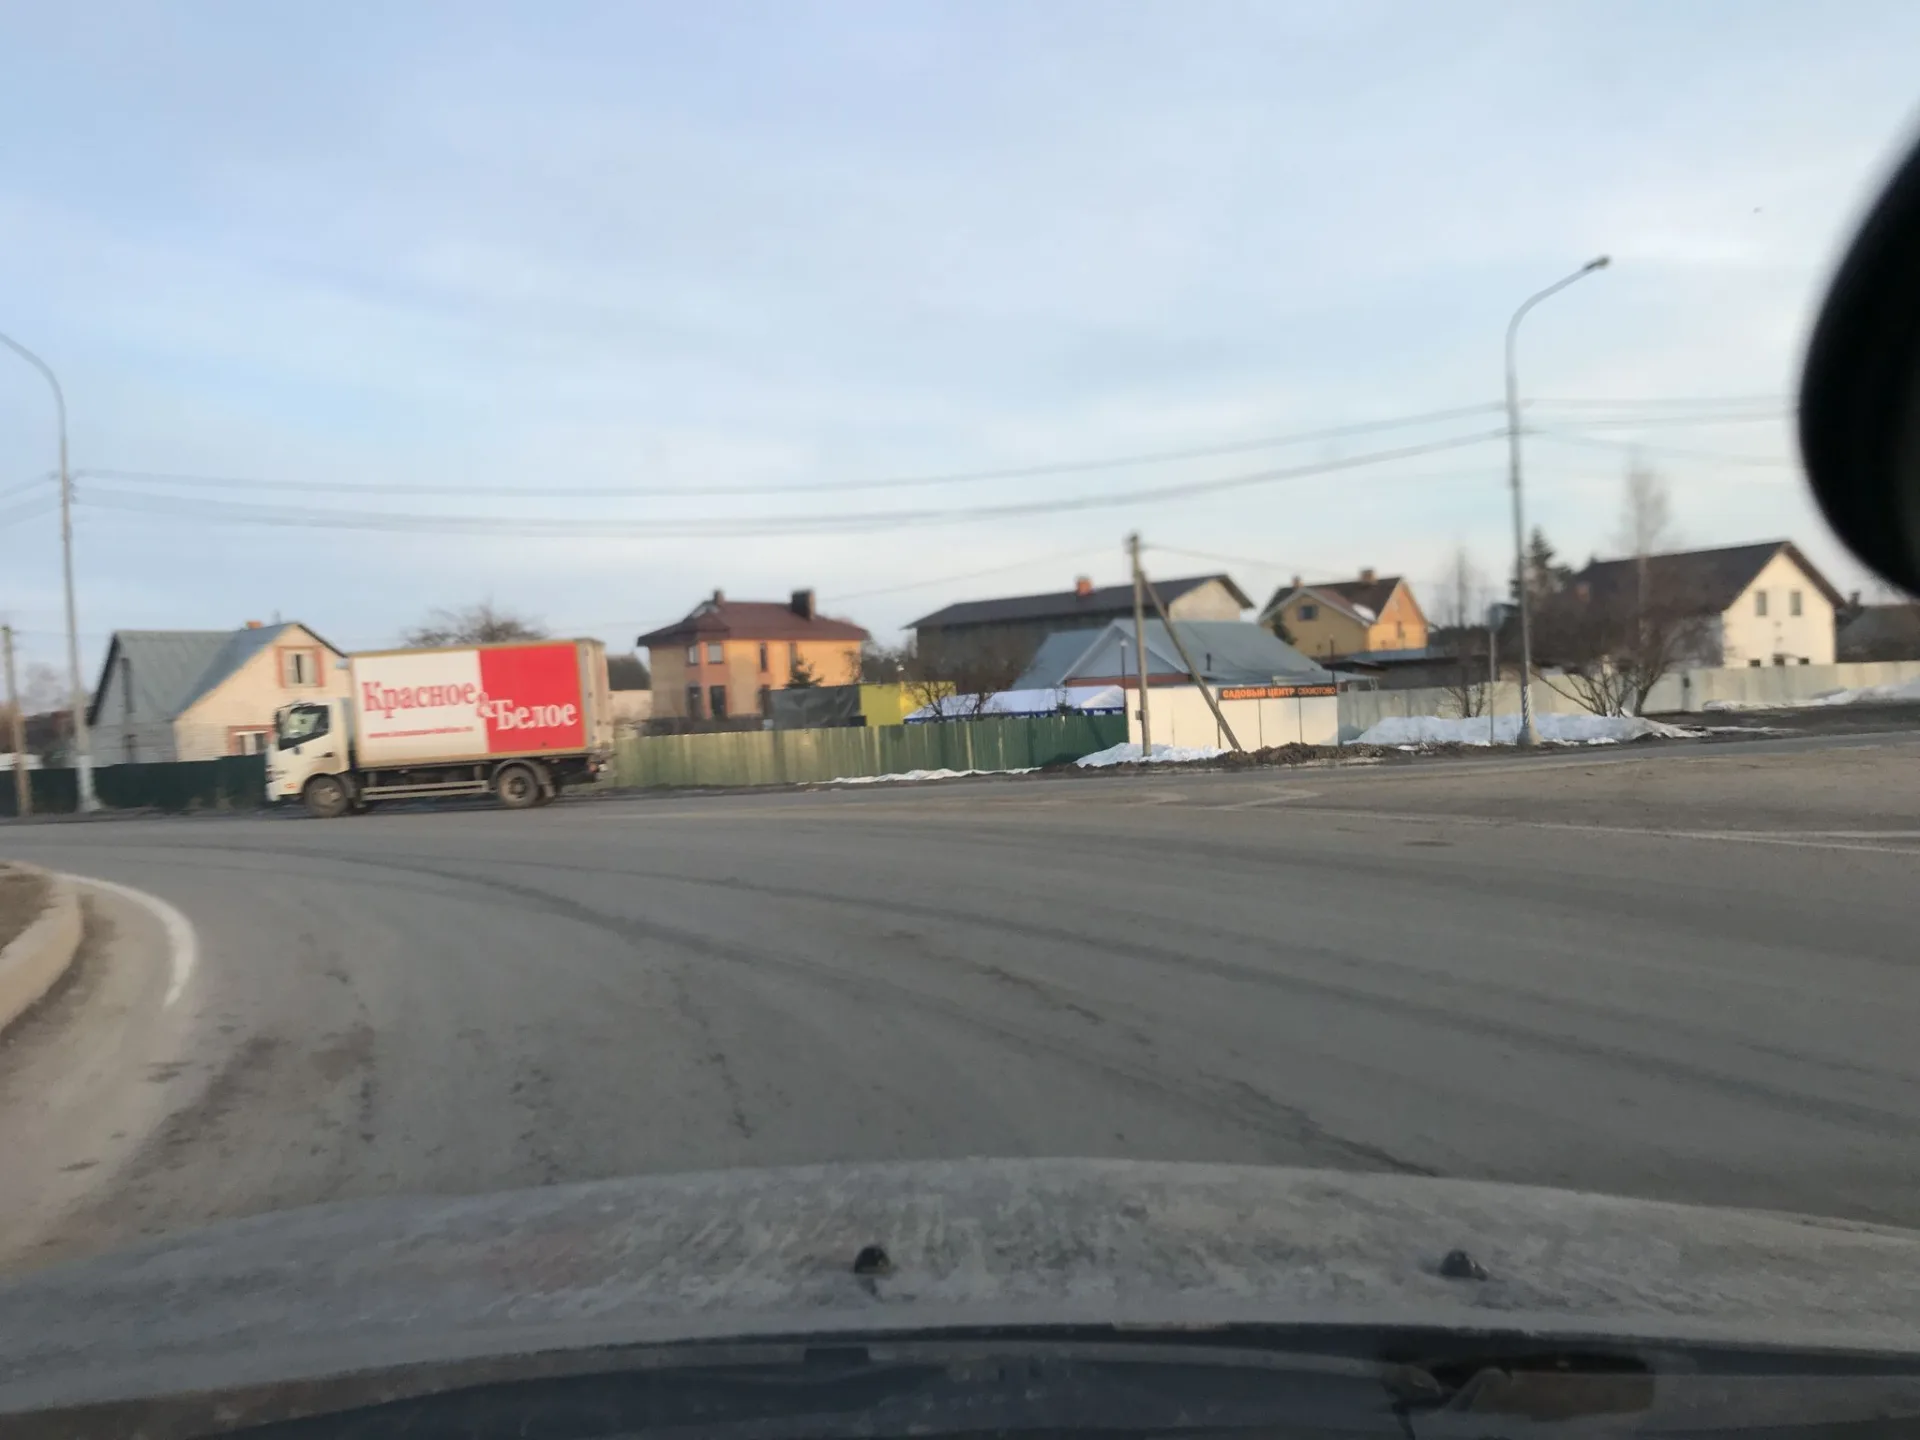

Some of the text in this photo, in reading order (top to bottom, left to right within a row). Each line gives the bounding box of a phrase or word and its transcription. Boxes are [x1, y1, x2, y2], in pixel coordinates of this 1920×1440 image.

[362, 681, 578, 731] Красное & Белое
[1222, 687, 1266, 699] САДОВЫЙ
[1267, 687, 1295, 698] ЦЕНТР
